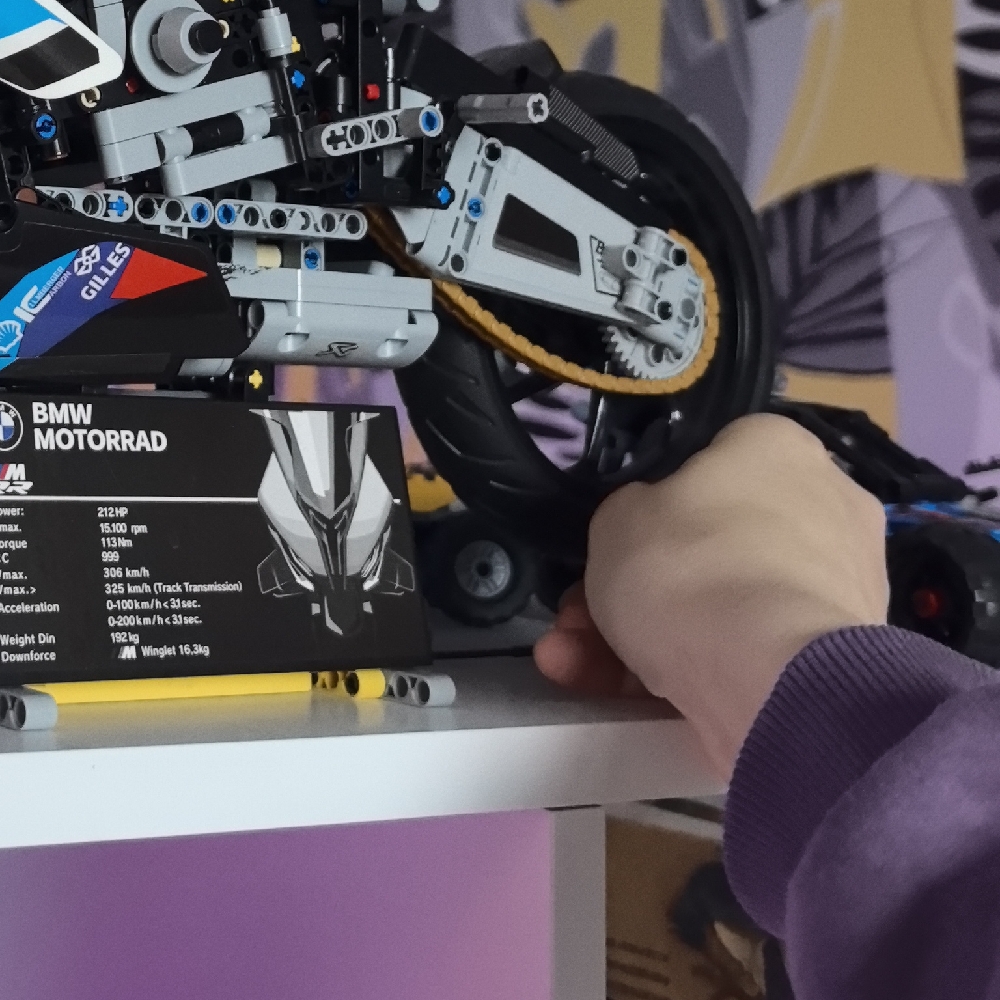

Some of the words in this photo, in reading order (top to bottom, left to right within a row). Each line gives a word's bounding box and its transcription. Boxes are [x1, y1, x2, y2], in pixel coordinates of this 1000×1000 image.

[81, 242, 131, 300] GILLES
[32, 402, 93, 425] BMW
[34, 428, 168, 452] MOTORRAD
[130, 524, 149, 536] rpm
[101, 550, 120, 562] 999
[103, 566, 123, 578] 306
[125, 566, 150, 578] km/h
[104, 582, 125, 594] 325
[127, 582, 152, 594] km/h
[153, 581, 183, 594] (Track
[183, 581, 243, 593] Transmission)
[0, 633, 36, 647] Weight
[37, 633, 56, 644] Din
[0, 650, 57, 662] Downforce
[140, 645, 177, 659] Winglet
